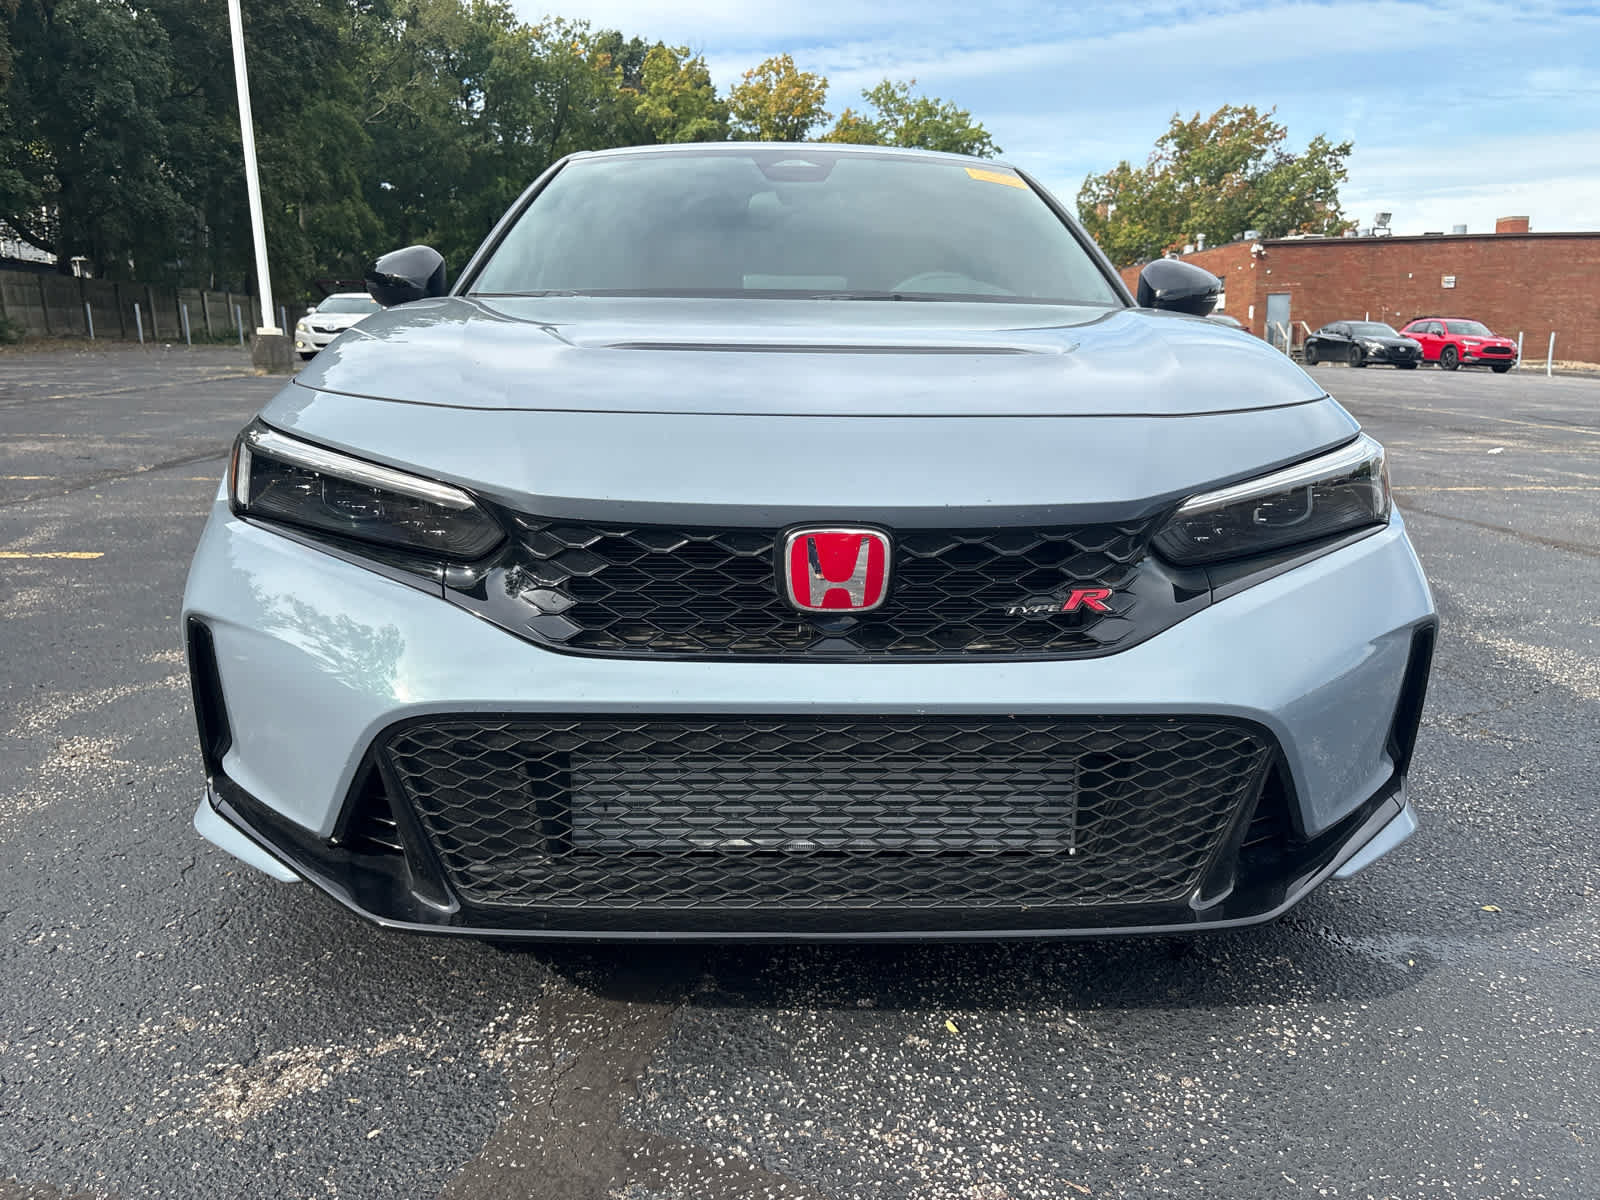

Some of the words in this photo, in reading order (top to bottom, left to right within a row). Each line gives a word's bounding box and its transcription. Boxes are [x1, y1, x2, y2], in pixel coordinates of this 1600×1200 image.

[807, 537, 870, 607] H
[1007, 603, 1060, 615] TYPE
[1062, 588, 1113, 612] R
